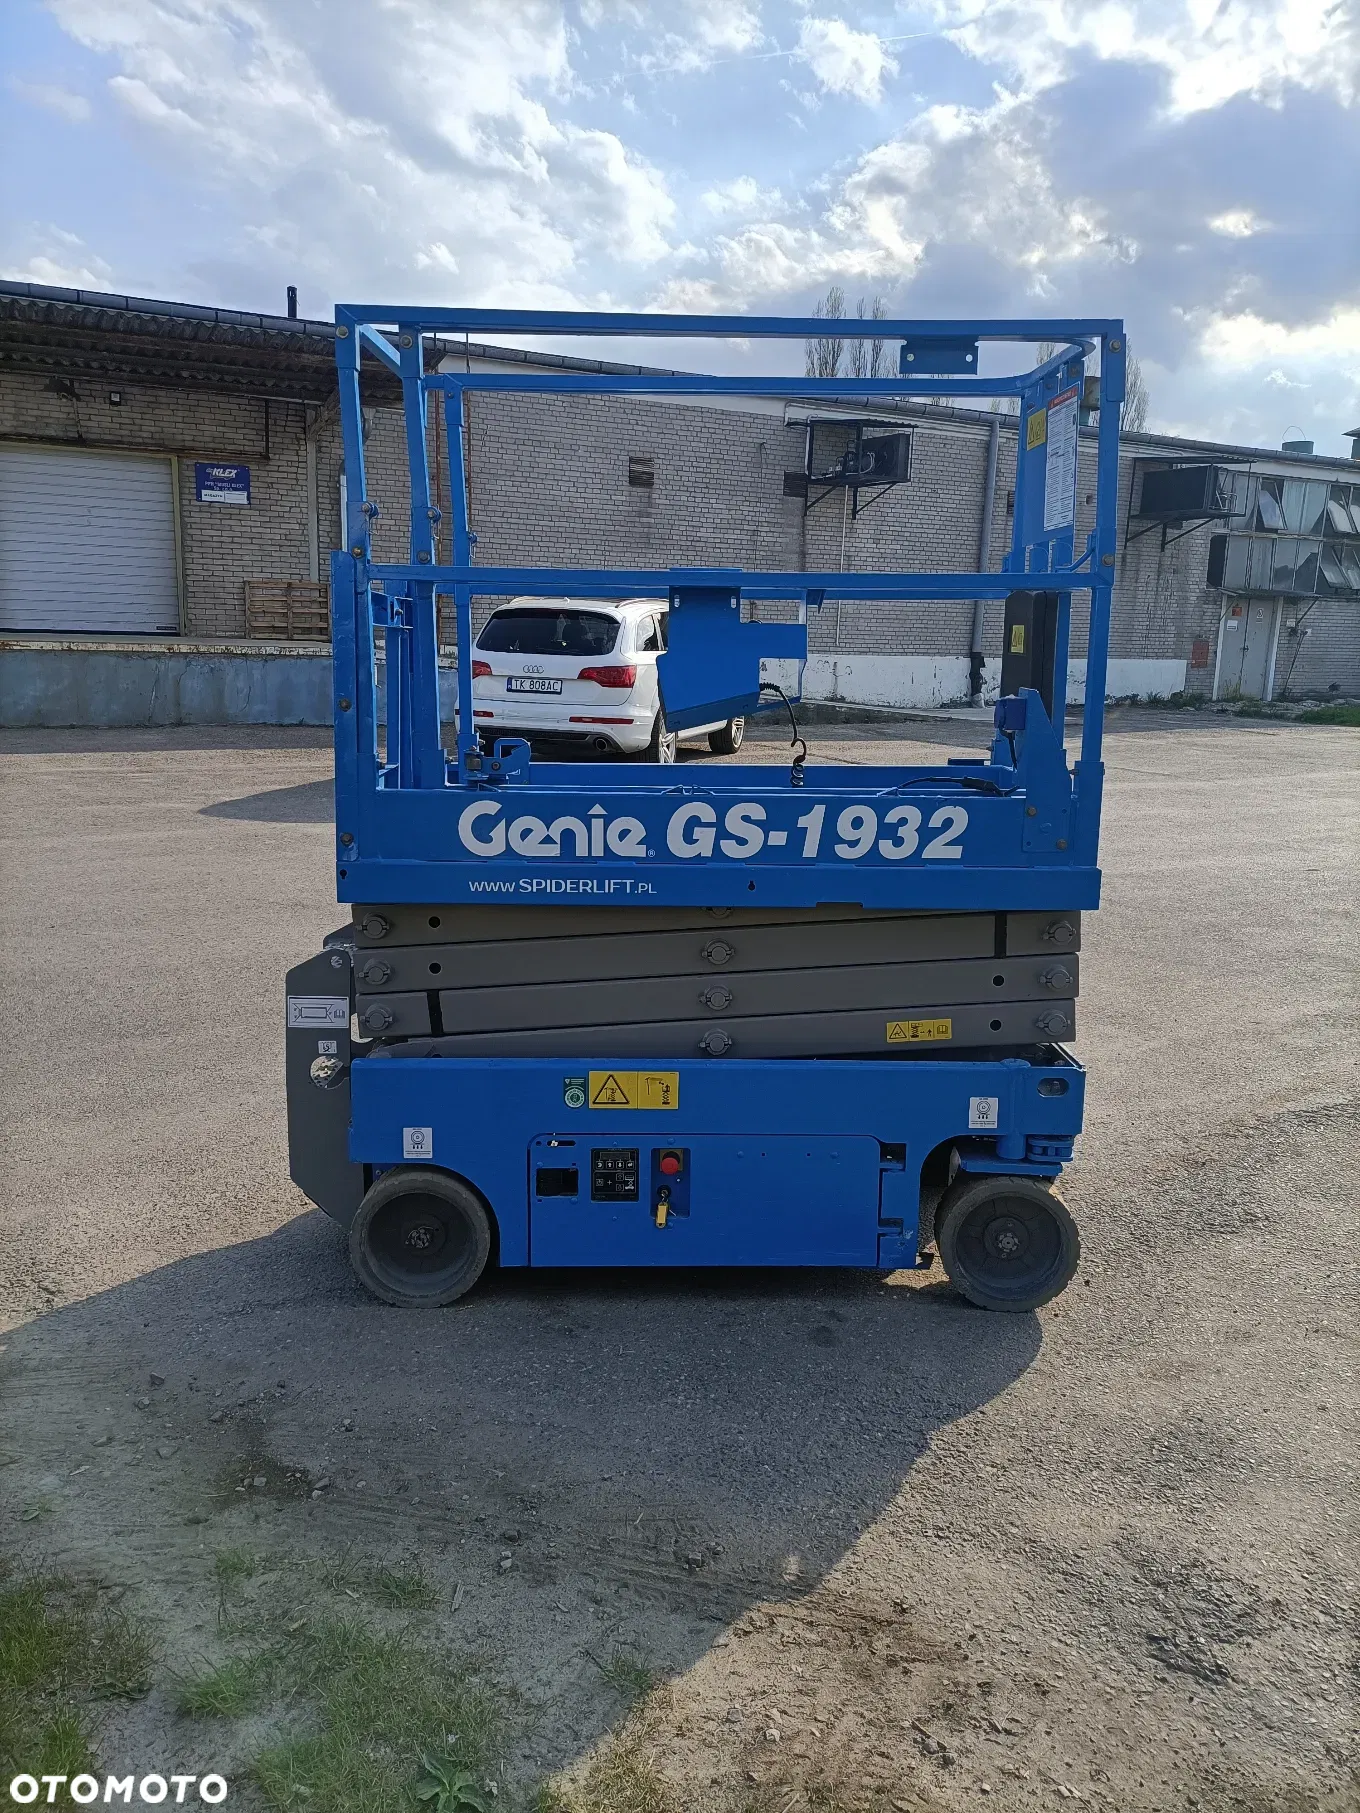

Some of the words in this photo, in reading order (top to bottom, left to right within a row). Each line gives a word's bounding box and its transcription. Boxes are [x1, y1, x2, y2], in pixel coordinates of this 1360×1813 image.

[212, 468, 237, 477] KLEX
[514, 679, 526, 690] TK
[529, 680, 559, 691] 808AC
[458, 800, 647, 858] Genie
[666, 801, 969, 860] GS-1932
